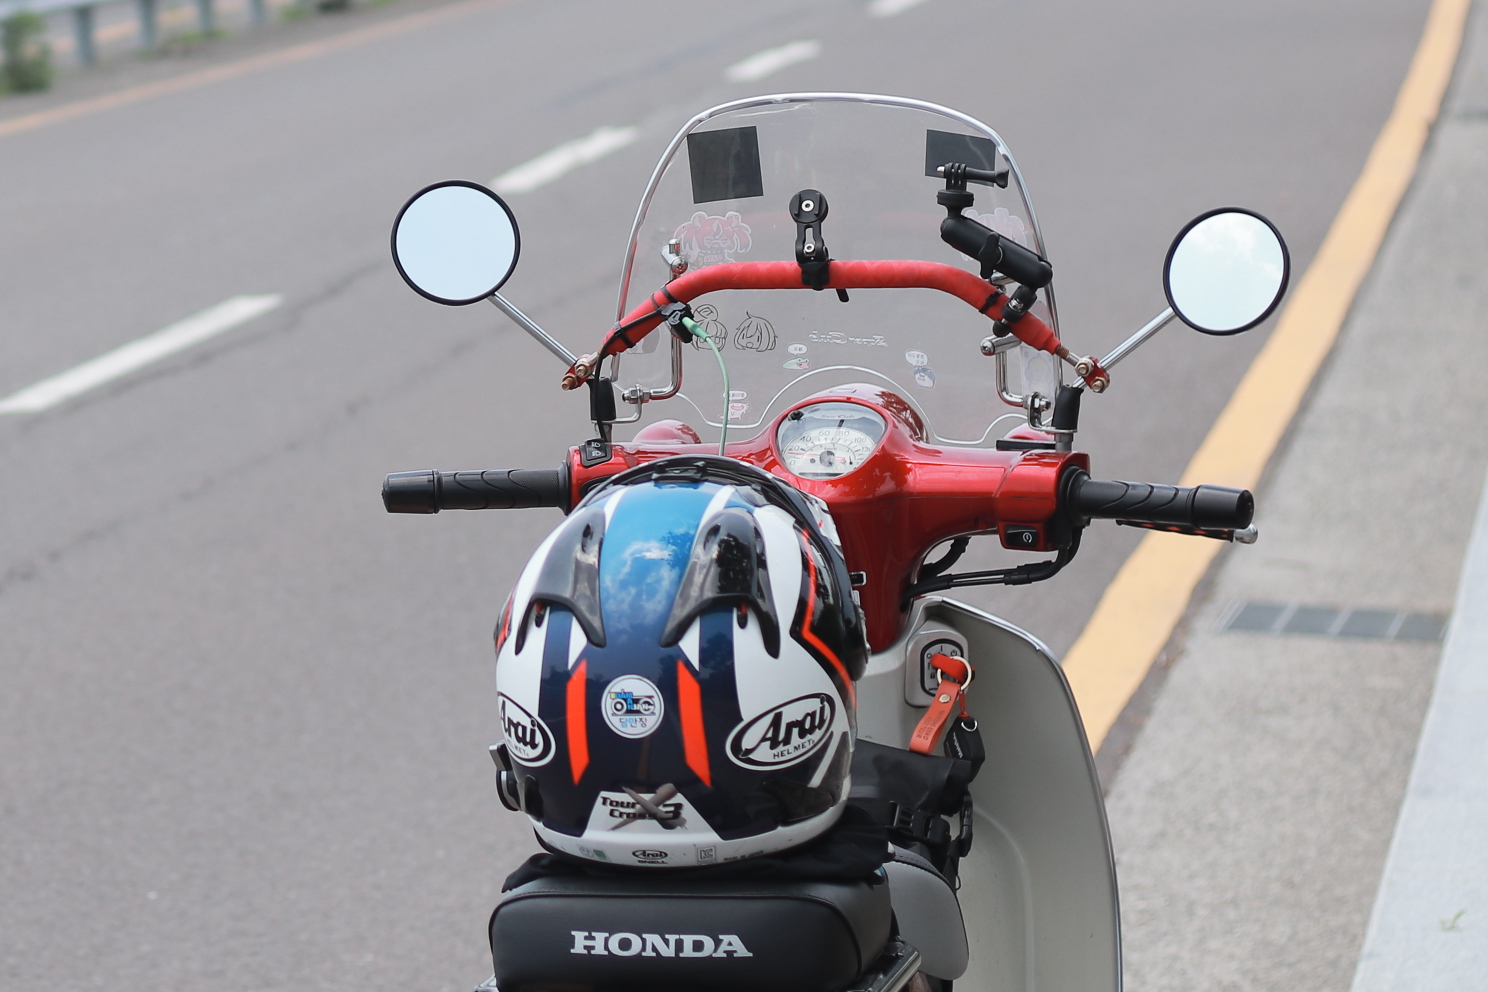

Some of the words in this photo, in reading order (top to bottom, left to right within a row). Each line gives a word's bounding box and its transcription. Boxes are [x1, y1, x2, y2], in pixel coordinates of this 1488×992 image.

[739, 695, 828, 759] Arai
[600, 796, 640, 809] Tour
[570, 930, 754, 958] HONDA
